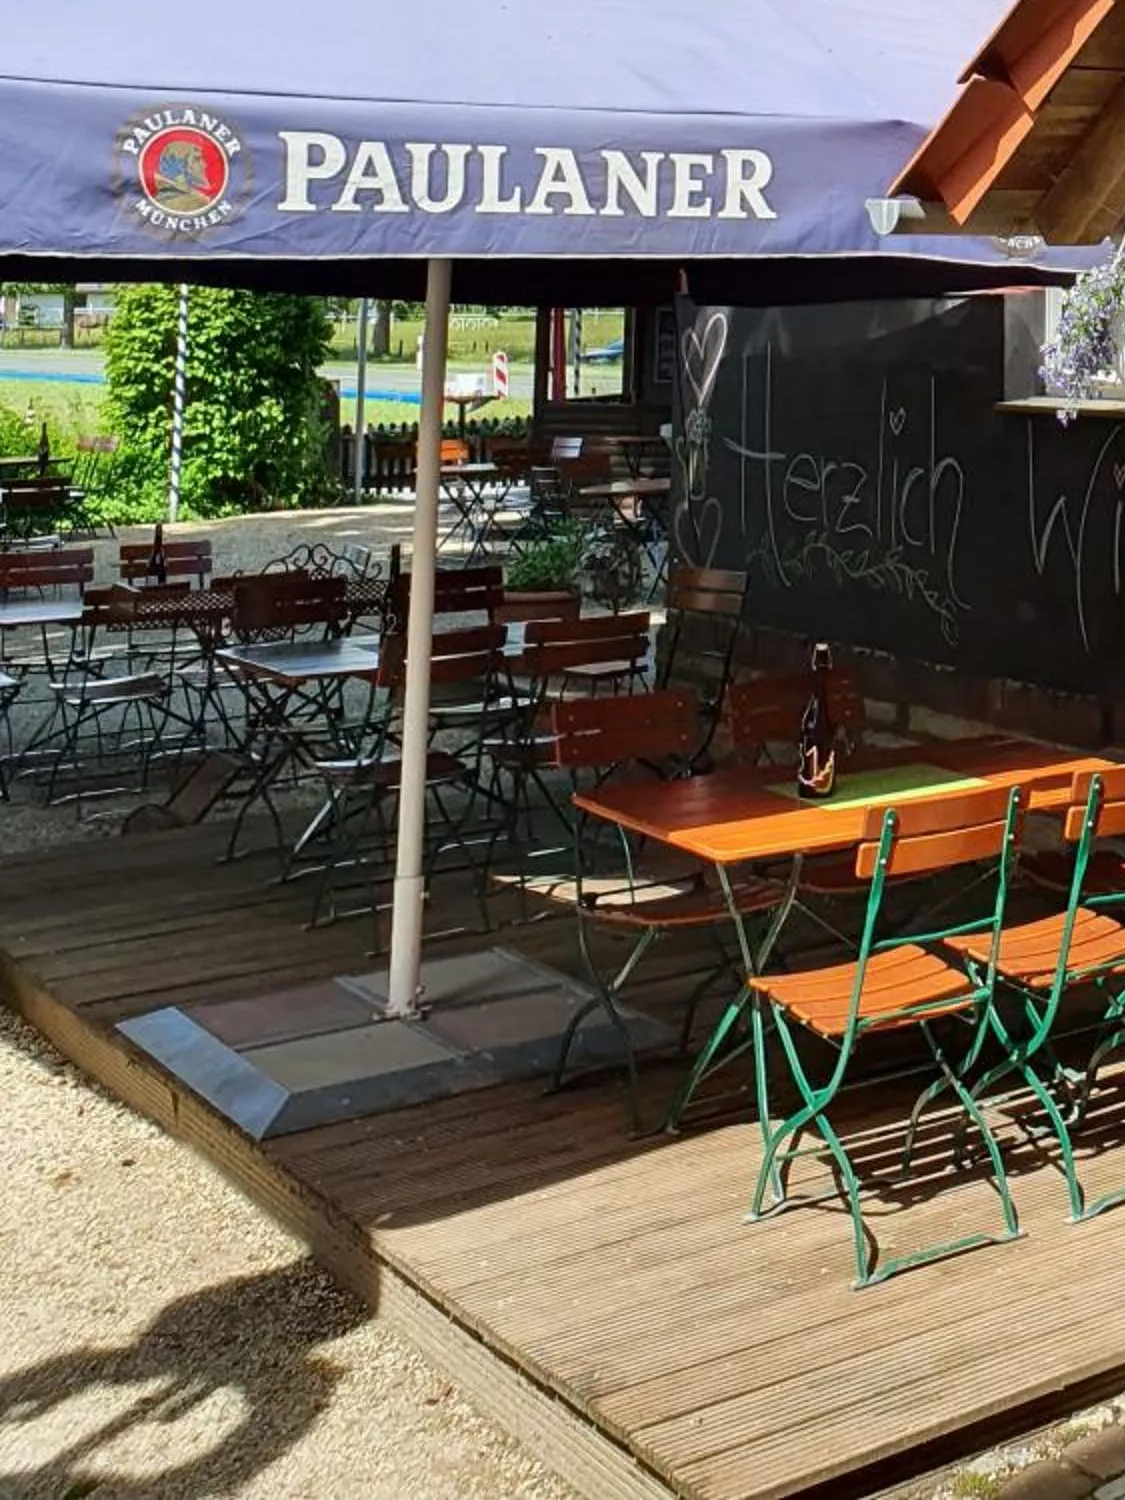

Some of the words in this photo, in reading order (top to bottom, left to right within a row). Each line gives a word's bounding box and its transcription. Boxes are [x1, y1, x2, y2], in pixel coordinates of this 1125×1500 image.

[122, 109, 241, 158] PAULANER
[277, 130, 778, 219] PAULANER
[721, 340, 972, 610] Herzlich
